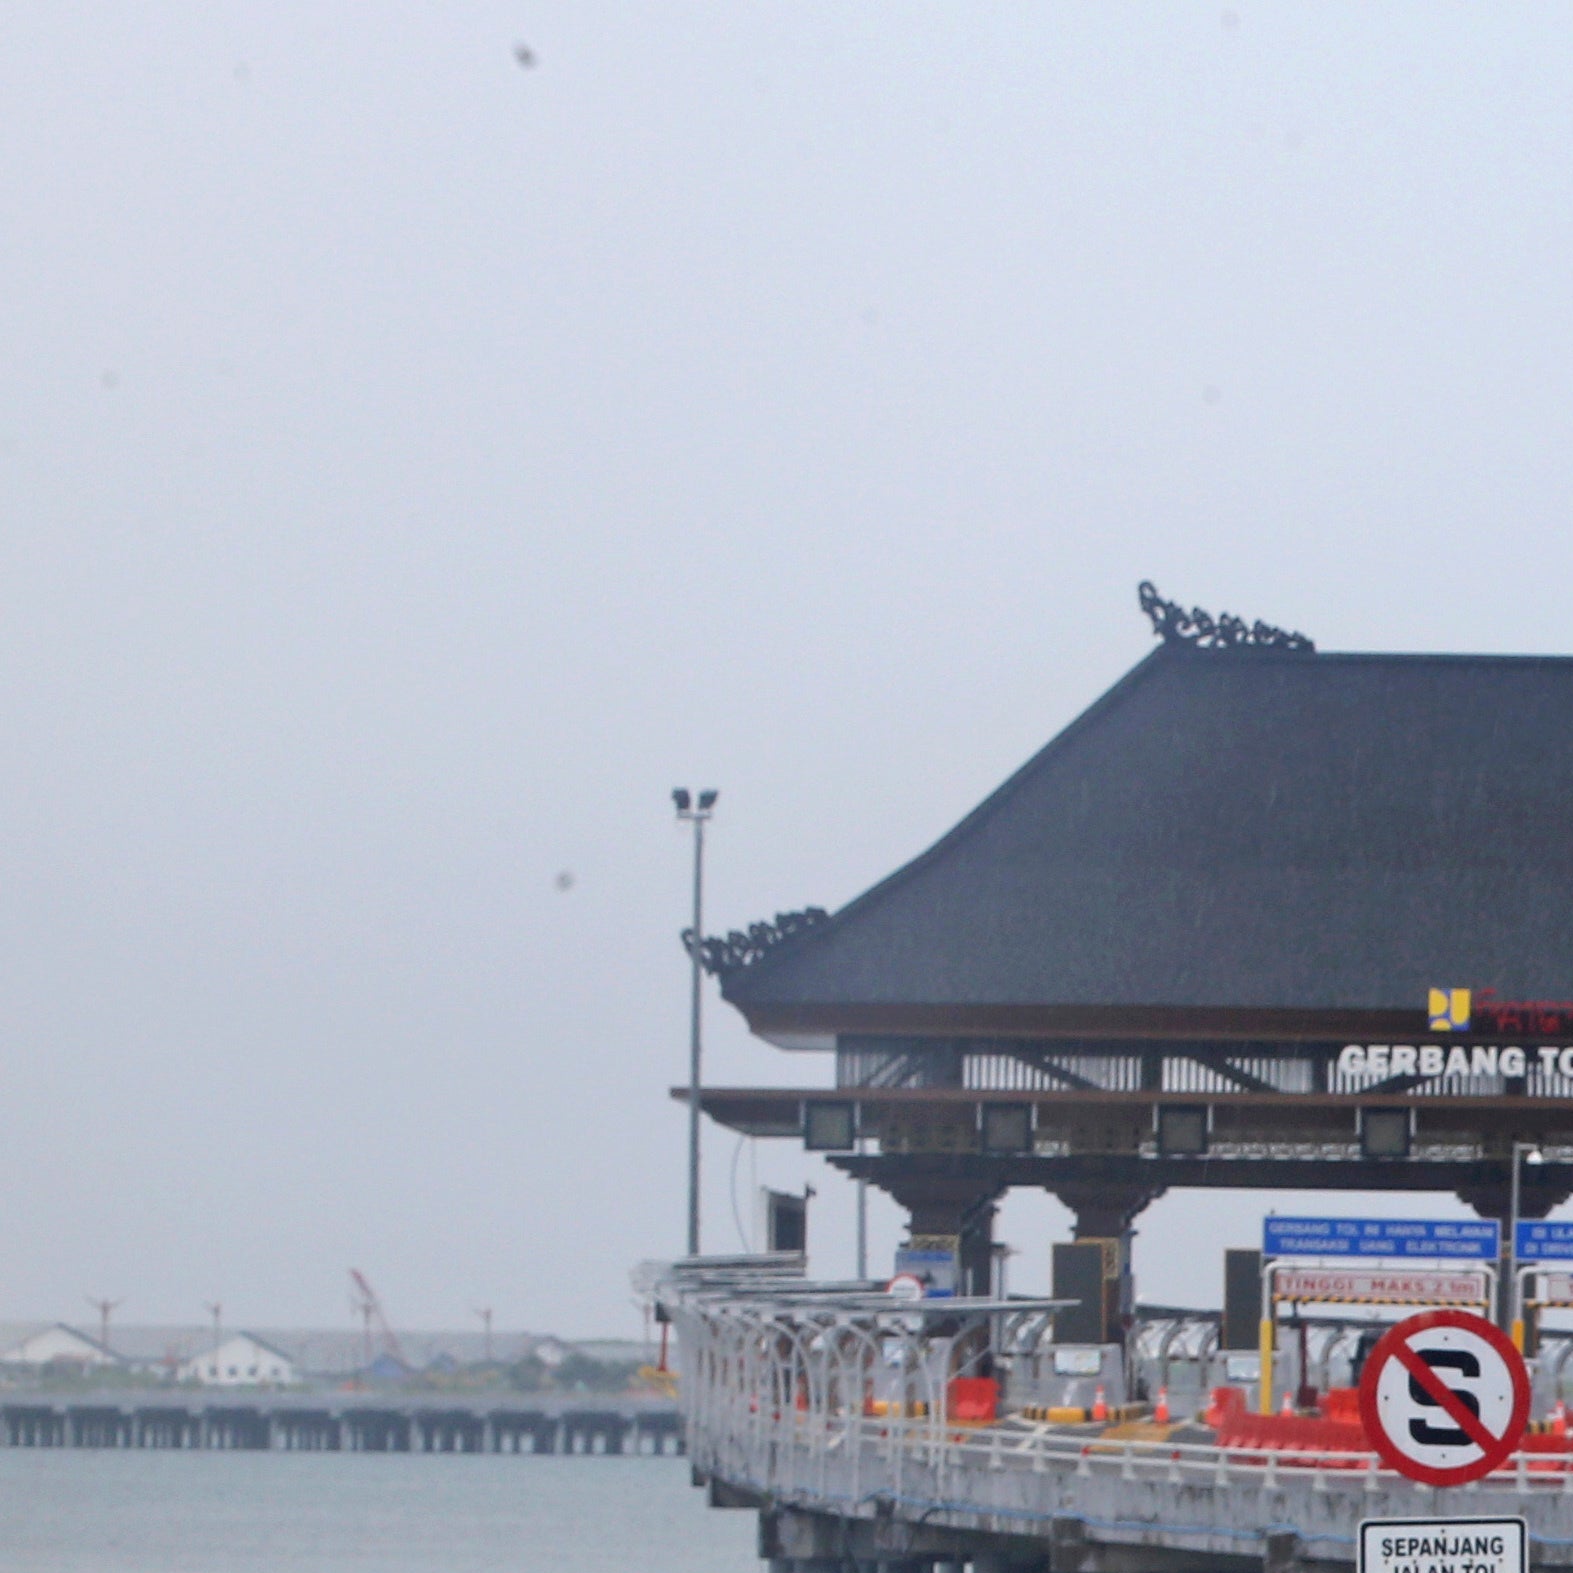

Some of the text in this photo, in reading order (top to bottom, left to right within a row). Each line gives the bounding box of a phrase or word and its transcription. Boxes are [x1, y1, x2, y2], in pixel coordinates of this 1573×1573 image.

[1338, 1044, 1526, 1077] GERBANG
[1285, 1276, 1355, 1291] TINGGI
[1371, 1279, 1425, 1293] MAKS
[1382, 1536, 1504, 1557] SEPANJANG
